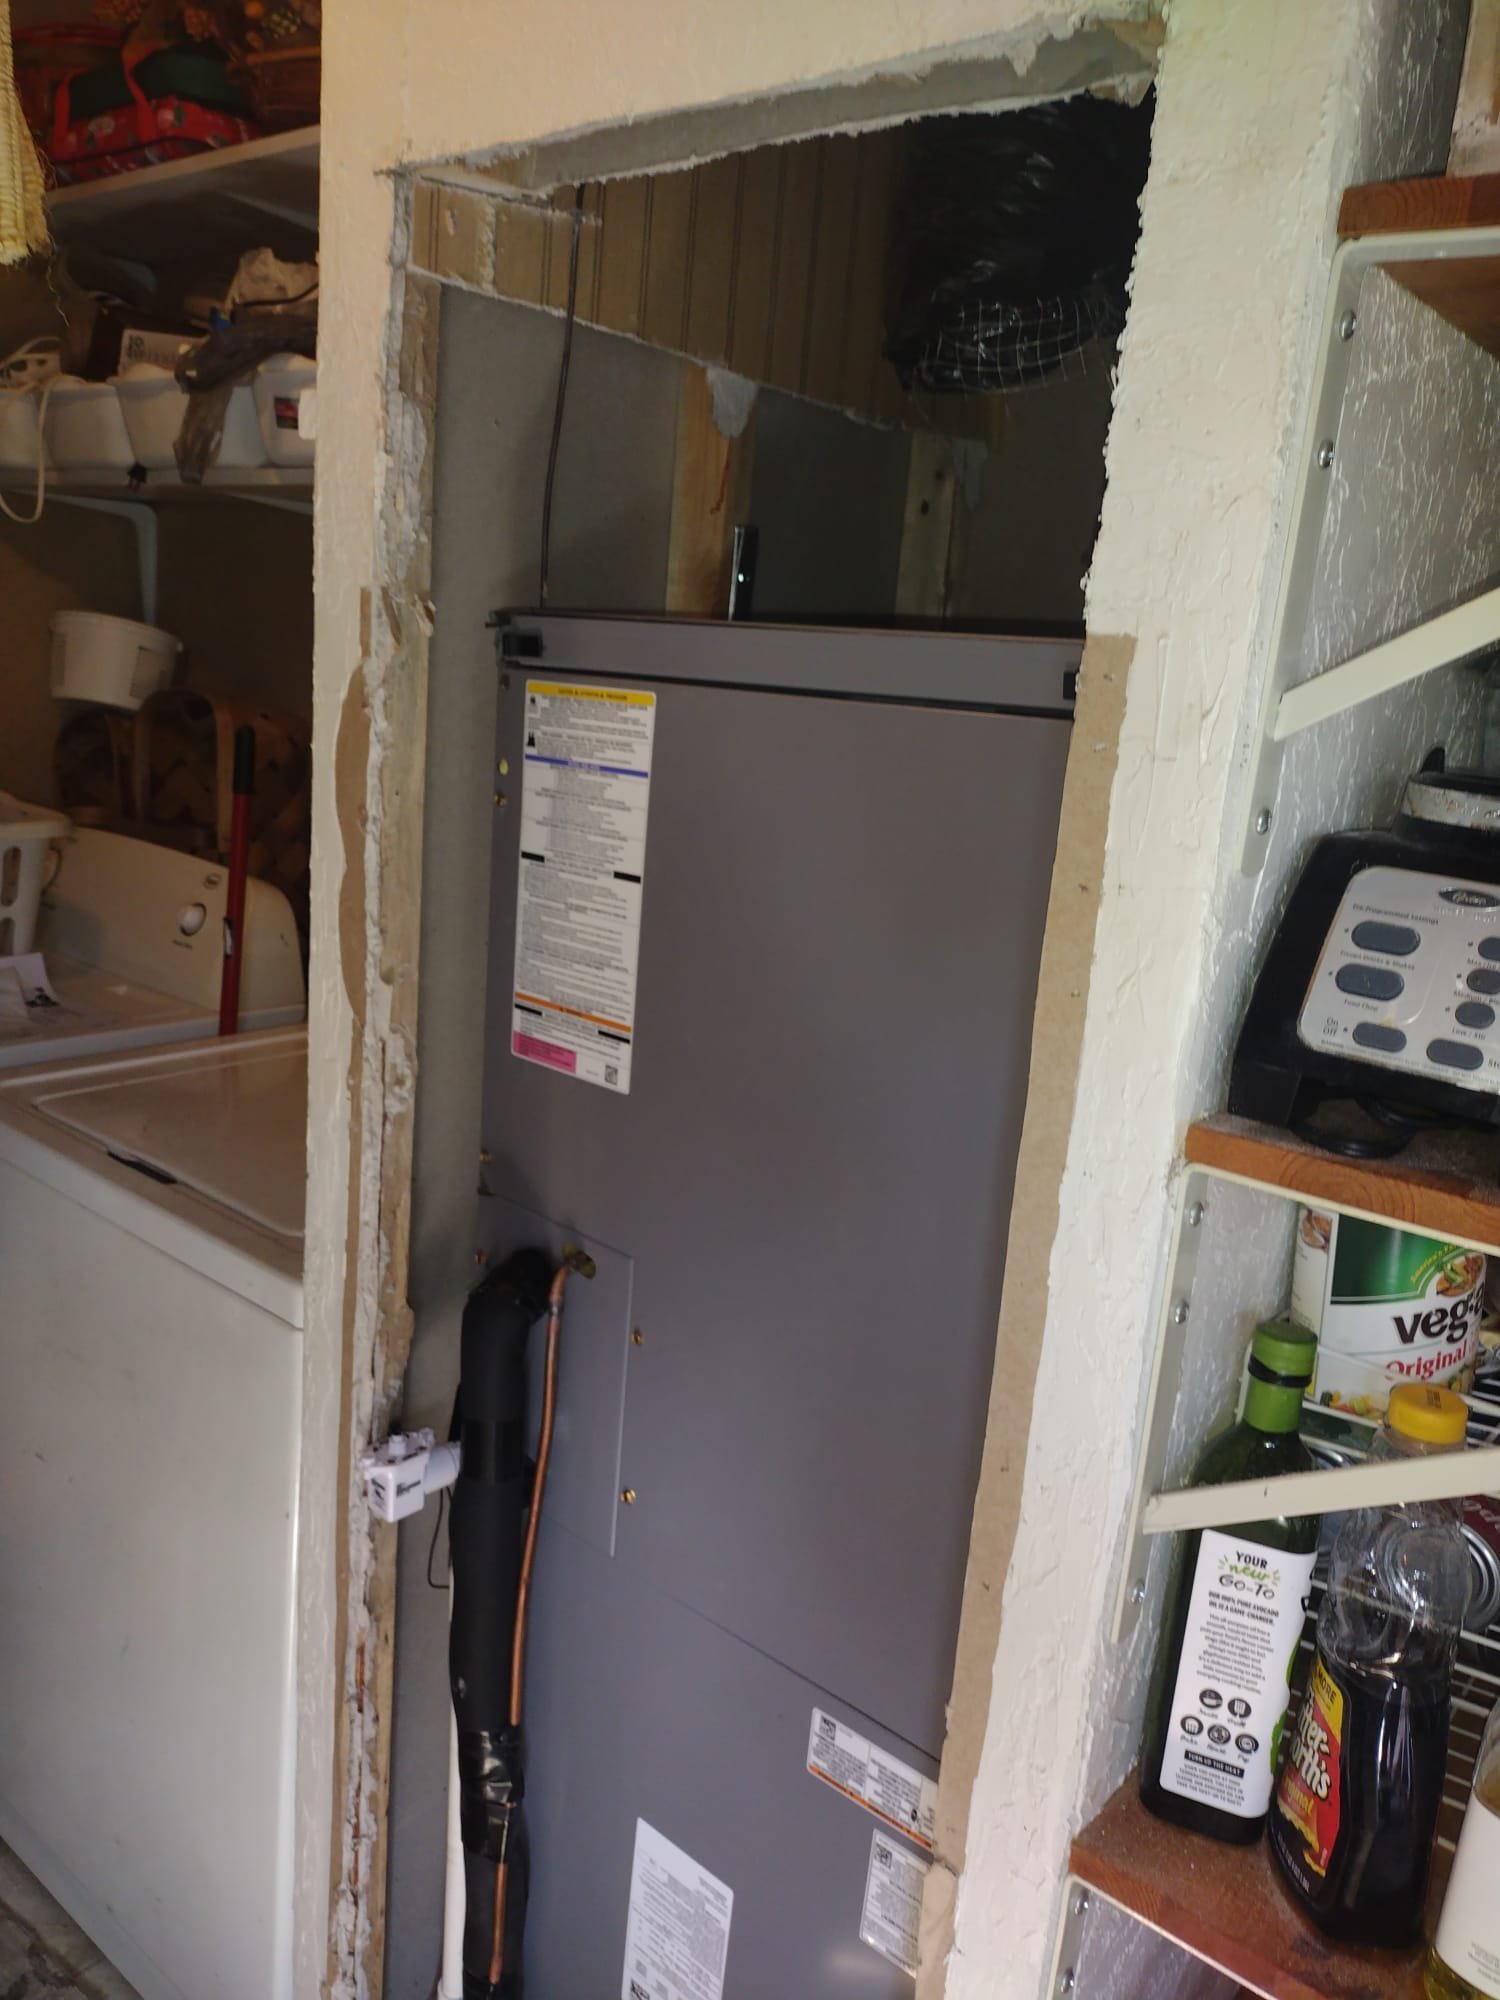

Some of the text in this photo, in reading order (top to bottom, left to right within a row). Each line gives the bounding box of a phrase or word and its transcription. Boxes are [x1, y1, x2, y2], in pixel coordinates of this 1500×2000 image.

[1385, 1339, 1468, 1382] Original
[1229, 1564, 1270, 1581] new
[1236, 1550, 1268, 1569] YOUR
[1316, 1669, 1338, 1705] MORE
